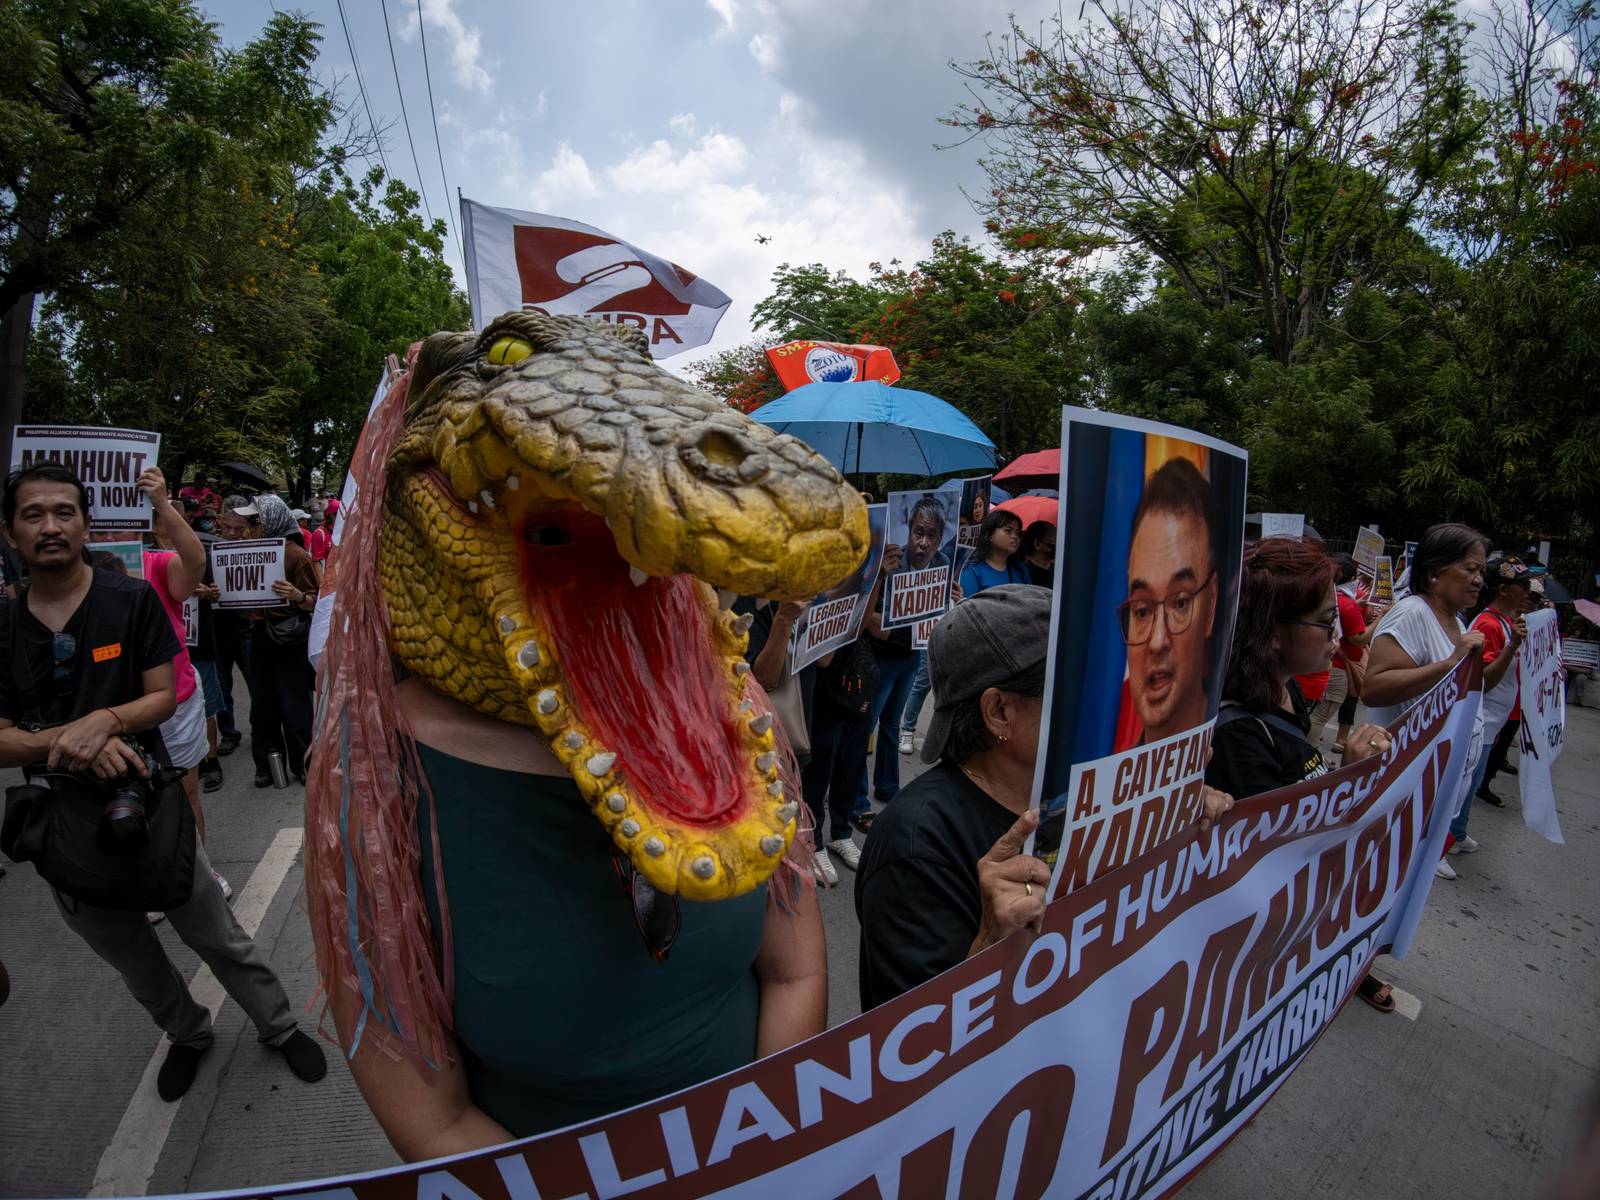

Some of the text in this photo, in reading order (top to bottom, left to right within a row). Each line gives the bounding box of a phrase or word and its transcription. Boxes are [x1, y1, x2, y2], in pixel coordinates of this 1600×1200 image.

[101, 487, 145, 508] NOW!
[216, 551, 277, 567] END DUTERTISMO
[225, 565, 266, 592] NOW!
[894, 568, 948, 591] VILLANUEVA
[810, 594, 855, 625] LEGARDA
[892, 584, 945, 619] KADIRI
[807, 614, 851, 649] KADIRI
[1072, 767, 1102, 822] A.
[1012, 901, 1106, 1004] OF
[1113, 804, 1290, 945] HUMAN
